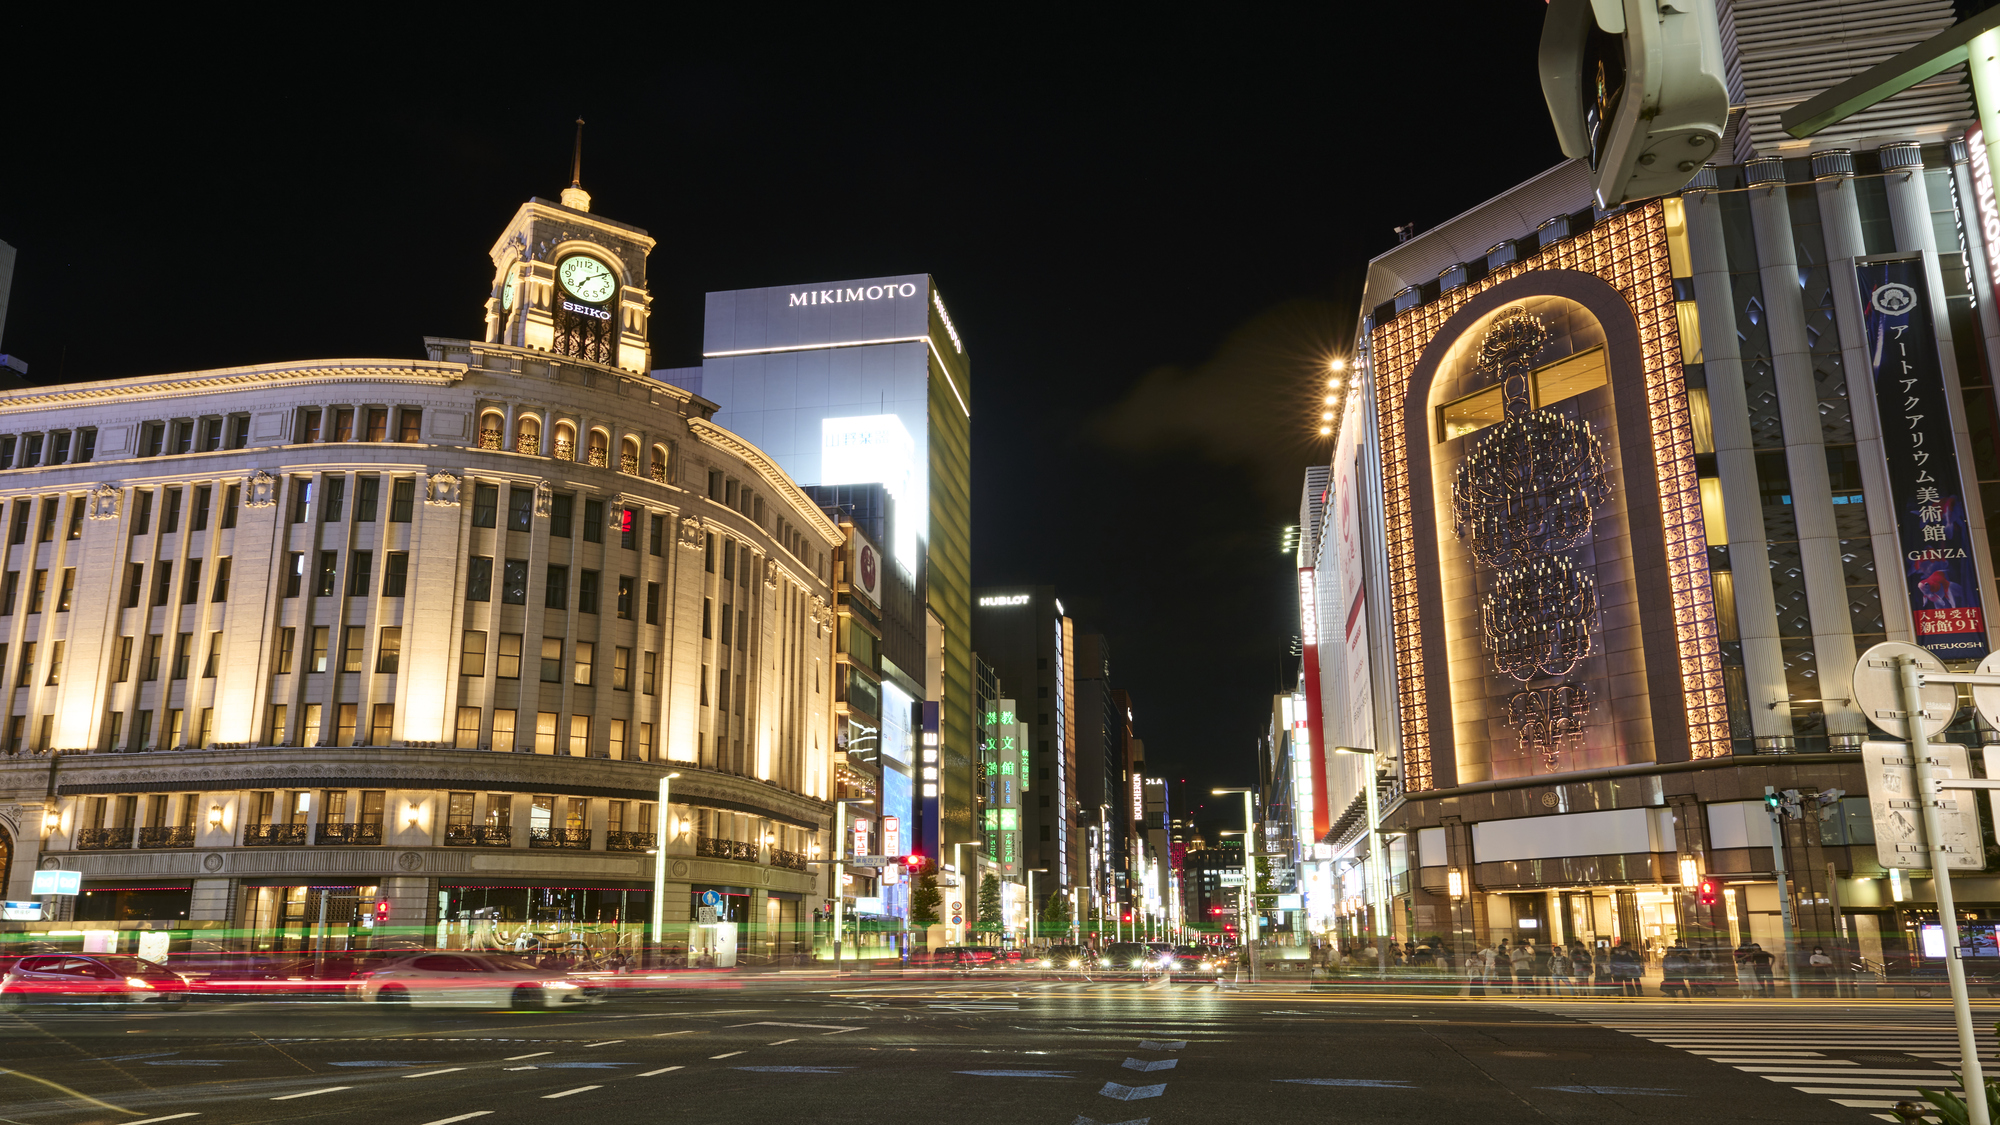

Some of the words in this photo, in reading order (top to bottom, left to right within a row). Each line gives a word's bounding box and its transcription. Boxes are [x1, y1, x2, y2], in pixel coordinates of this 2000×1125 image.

[585, 261, 593, 269] 12
[789, 283, 916, 307] MIKIMOTO
[563, 302, 610, 320] SEIKO
[1890, 324, 1946, 542] アートアクアリウム美術館
[1908, 548, 1967, 560] GINZA
[980, 595, 1029, 606] HUBLOT
[1300, 571, 1316, 645] MITSUKOSHI
[1920, 609, 1976, 620] 入場受付
[1921, 620, 1978, 633] 新館9F
[1001, 711, 1014, 776] 教文館
[1133, 774, 1142, 820] BOUCHERON
